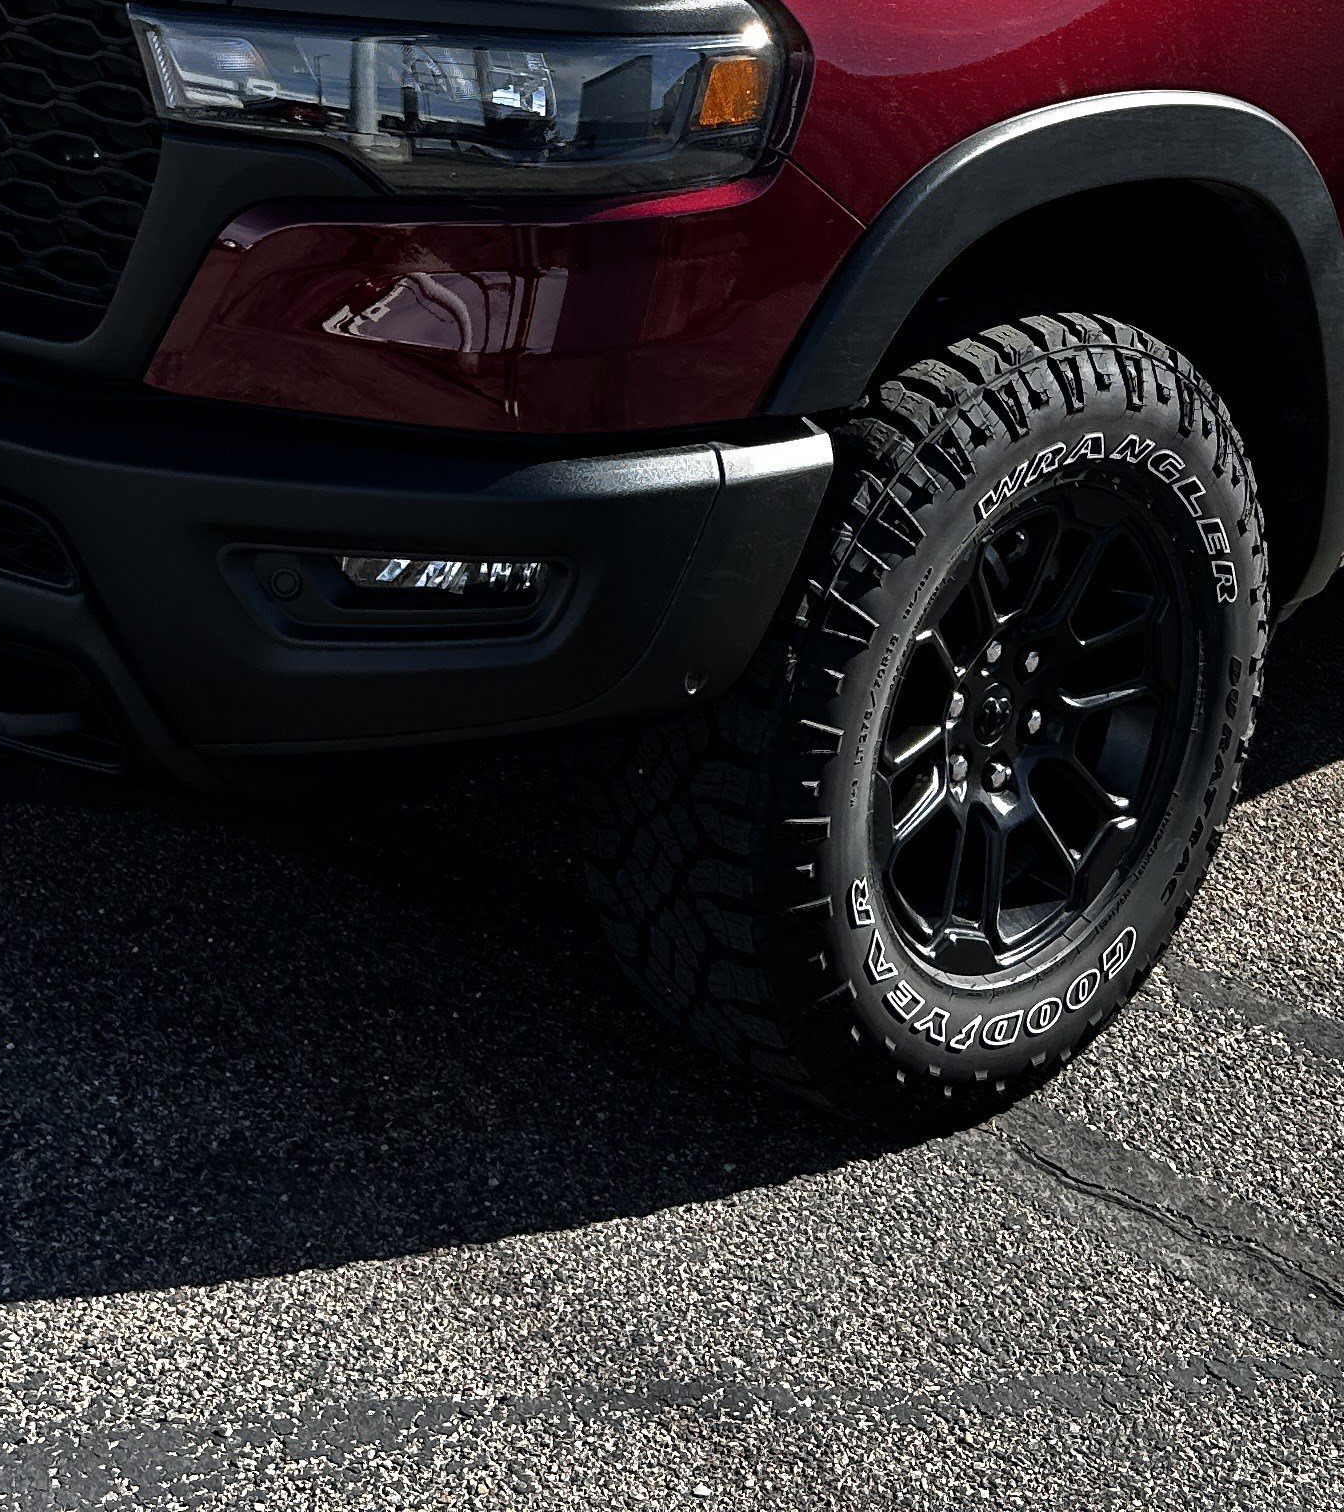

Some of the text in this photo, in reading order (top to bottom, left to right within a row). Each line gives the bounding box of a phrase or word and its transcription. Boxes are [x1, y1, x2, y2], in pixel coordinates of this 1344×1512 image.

[973, 430, 1238, 605] WRANGLER
[1160, 655, 1243, 906] DURATRAC
[846, 875, 1137, 1052] GOODYEAR
